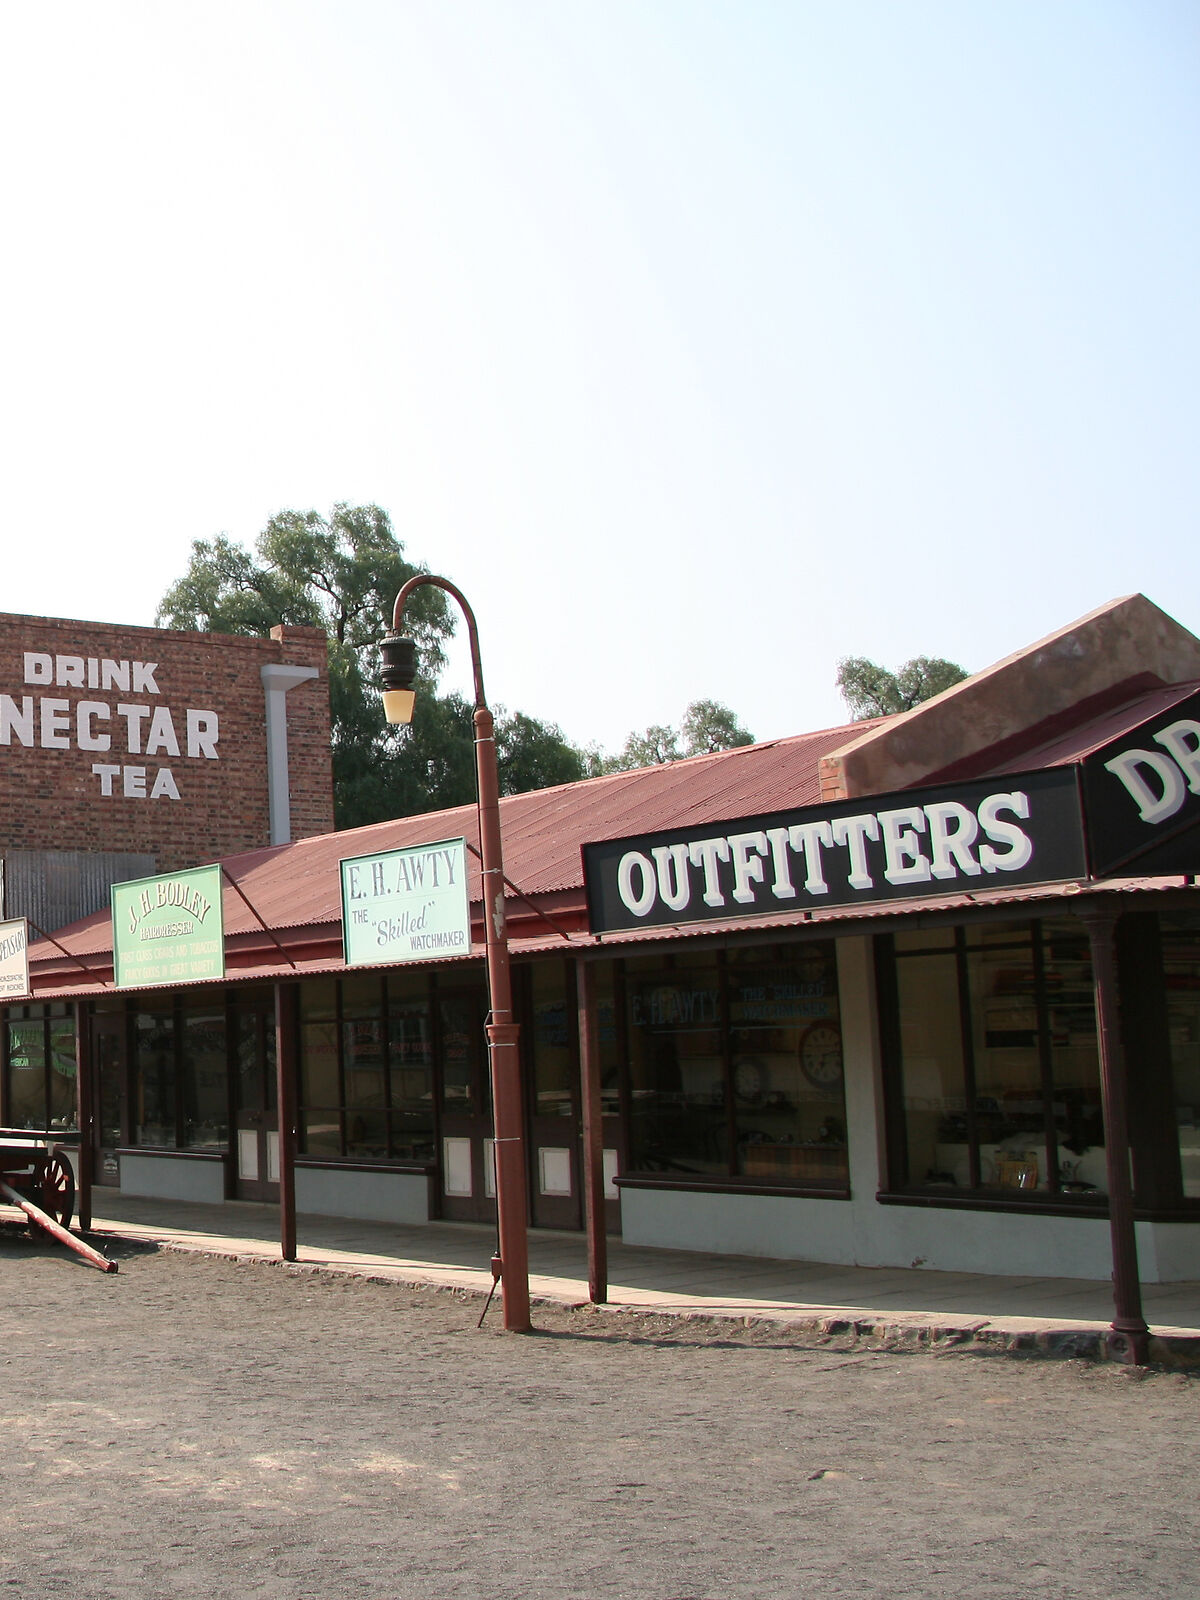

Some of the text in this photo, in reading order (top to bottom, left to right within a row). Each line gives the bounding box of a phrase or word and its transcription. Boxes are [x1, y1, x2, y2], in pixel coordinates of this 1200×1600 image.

[24, 652, 161, 694] DRINK
[0, 694, 219, 760] NECTAR
[92, 763, 181, 800] TEA
[617, 791, 1034, 917] OUTFITTERS
[348, 848, 457, 900] E. H. AWTY
[156, 880, 211, 925] BODLEY
[352, 909, 368, 924] THE
[139, 920, 195, 942] HAIRDRESSER
[410, 930, 465, 951] WATCHMAKER
[120, 951, 135, 964] FIRST
[136, 949, 152, 962] CLASS
[154, 946, 173, 959] CIGARS
[174, 944, 188, 957] AND
[162, 965, 169, 977] IN
[170, 963, 188, 976] GREAT
[191, 959, 215, 974] VARIETY
